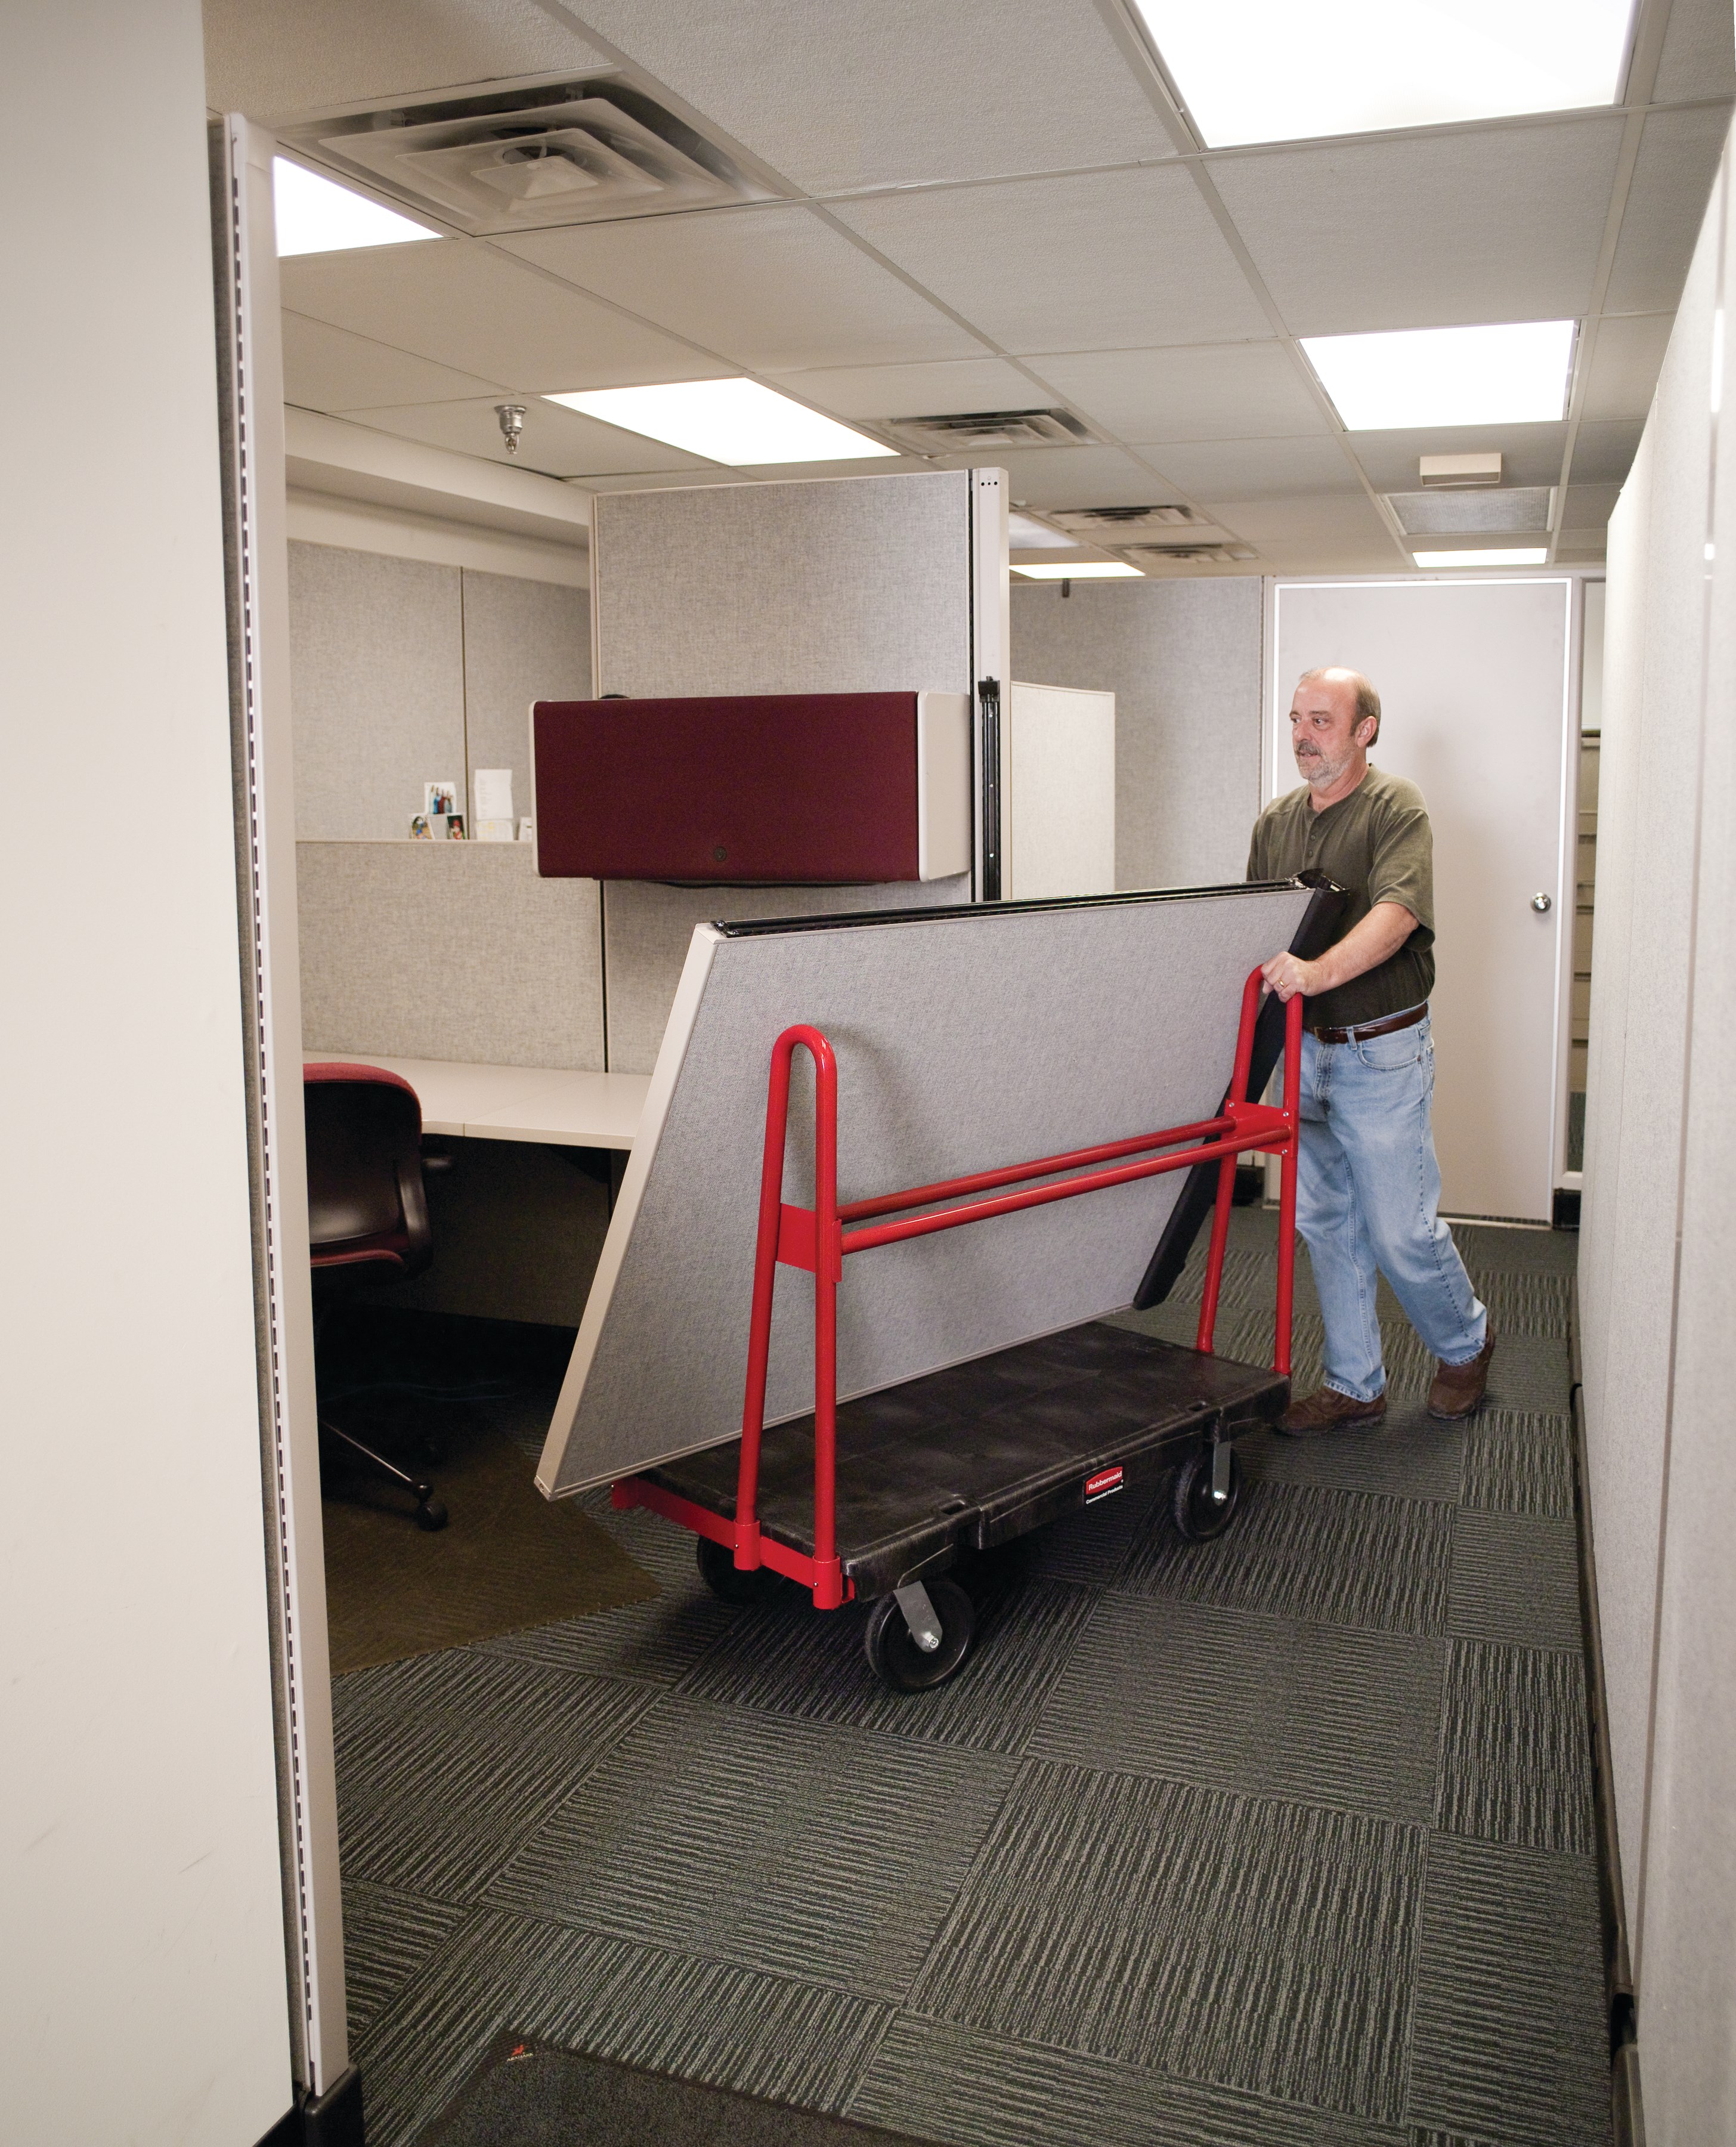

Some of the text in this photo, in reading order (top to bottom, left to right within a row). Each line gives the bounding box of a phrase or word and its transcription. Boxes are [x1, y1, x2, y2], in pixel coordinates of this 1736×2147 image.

[1088, 1470, 1122, 1490] Rubbermaid
[1086, 1485, 1123, 1504] Commercial Products
[507, 2053, 533, 2061] ARAMARK
